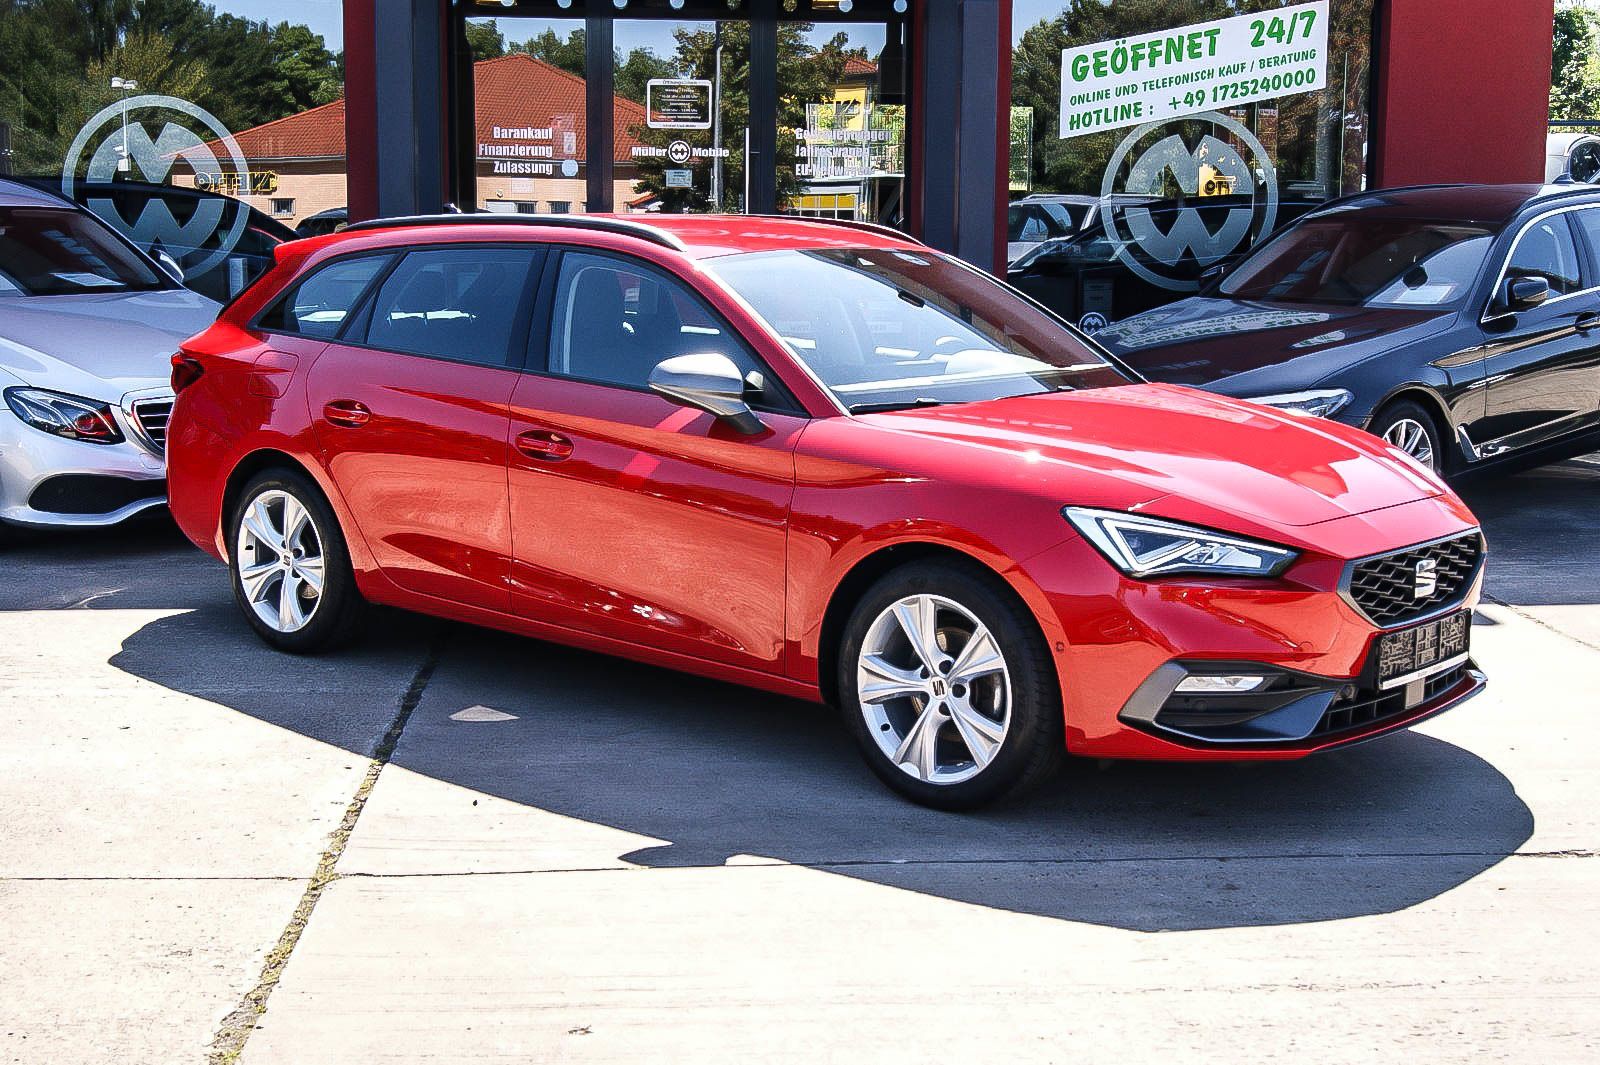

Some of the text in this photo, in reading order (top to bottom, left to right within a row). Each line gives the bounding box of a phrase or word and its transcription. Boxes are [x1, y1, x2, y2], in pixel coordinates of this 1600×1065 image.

[1071, 9, 1317, 82] GEÖFFNET 24/7
[1070, 48, 1317, 106] ONLINE UND TELEFONISCH KAUF / BERATUNG
[1069, 101, 1143, 130] HOTLINE
[1168, 90, 1206, 110] +49
[1212, 68, 1316, 103] 1725240000
[493, 126, 553, 139] Barankauf
[478, 143, 553, 158] Finanzierung
[631, 146, 667, 157] Müller
[692, 147, 730, 157] Mobile
[493, 161, 553, 175] Zulassung
